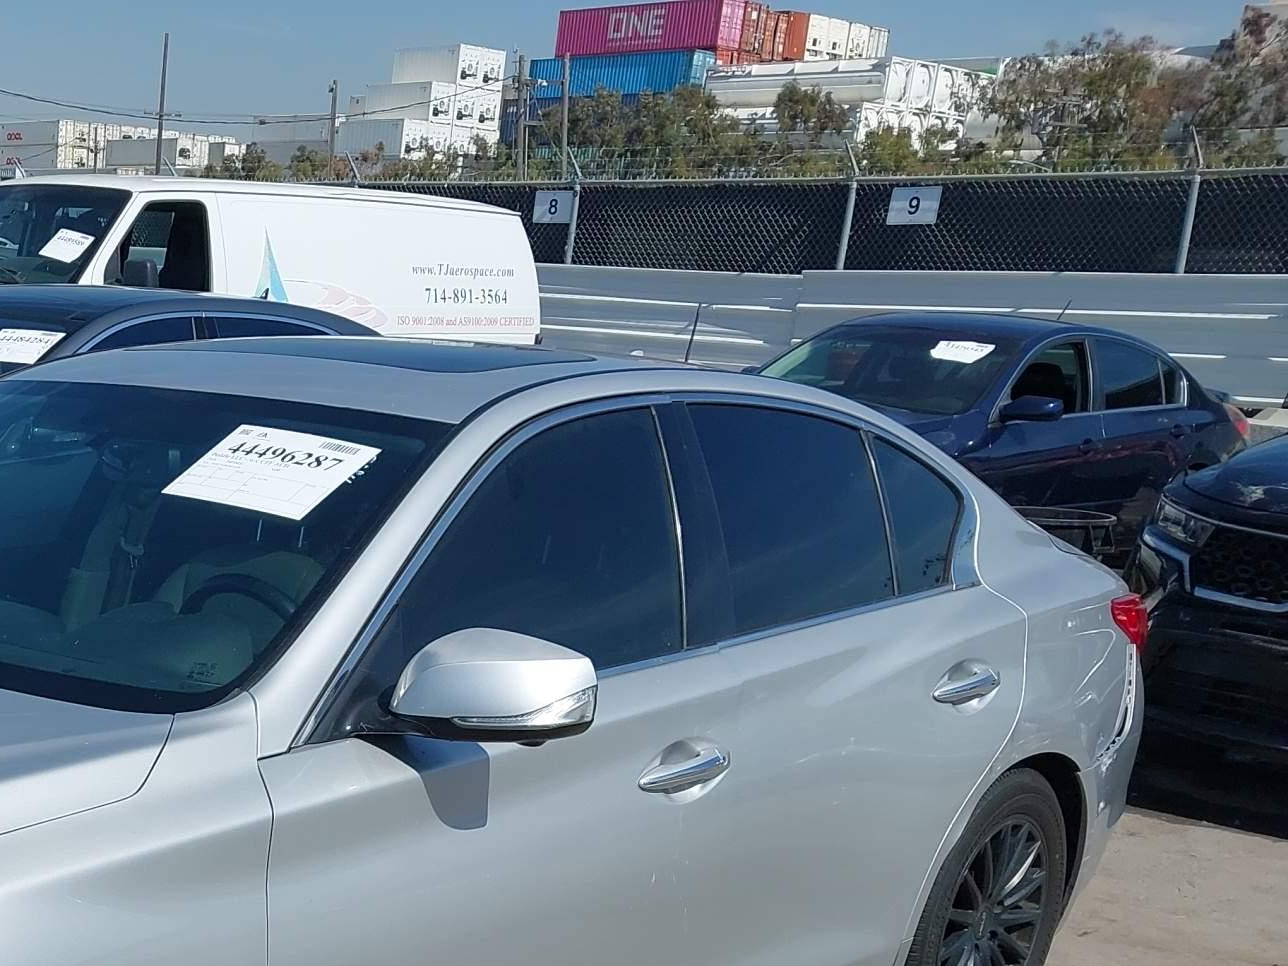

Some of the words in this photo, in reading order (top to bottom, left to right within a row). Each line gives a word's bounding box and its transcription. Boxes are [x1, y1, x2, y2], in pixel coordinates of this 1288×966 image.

[607, 8, 665, 39] ONE
[7, 132, 23, 141] OOCL
[548, 198, 558, 215] 8
[907, 196, 920, 215] 9
[412, 263, 515, 280] www.TJaerospace.com
[425, 287, 508, 305] 714-891-3564
[397, 315, 410, 326] ISO
[445, 316, 457, 326] and
[499, 316, 535, 327] CERTIFIED
[228, 441, 344, 471] 44496287
